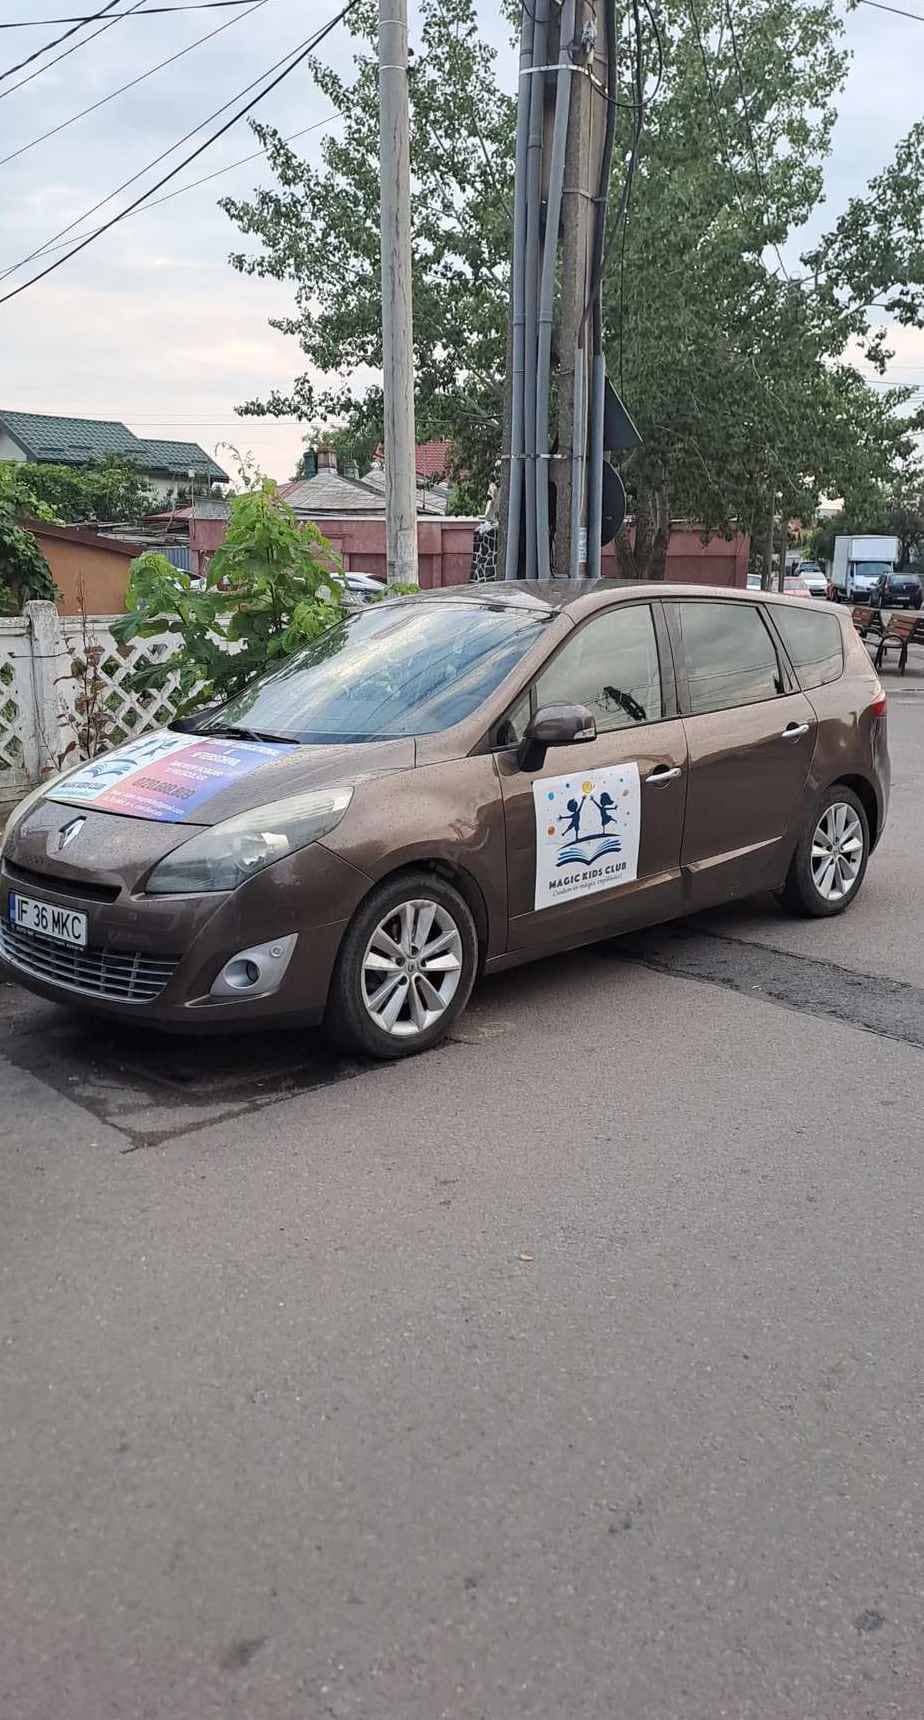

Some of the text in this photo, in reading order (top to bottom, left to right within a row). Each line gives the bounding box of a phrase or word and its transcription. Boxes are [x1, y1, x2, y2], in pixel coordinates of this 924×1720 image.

[549, 874, 580, 889] MAGIC
[582, 868, 603, 880] KIDS
[605, 862, 627, 875] CLUB
[17, 899, 29, 921] IF
[33, 904, 48, 930] 36
[52, 910, 82, 940] MKC
